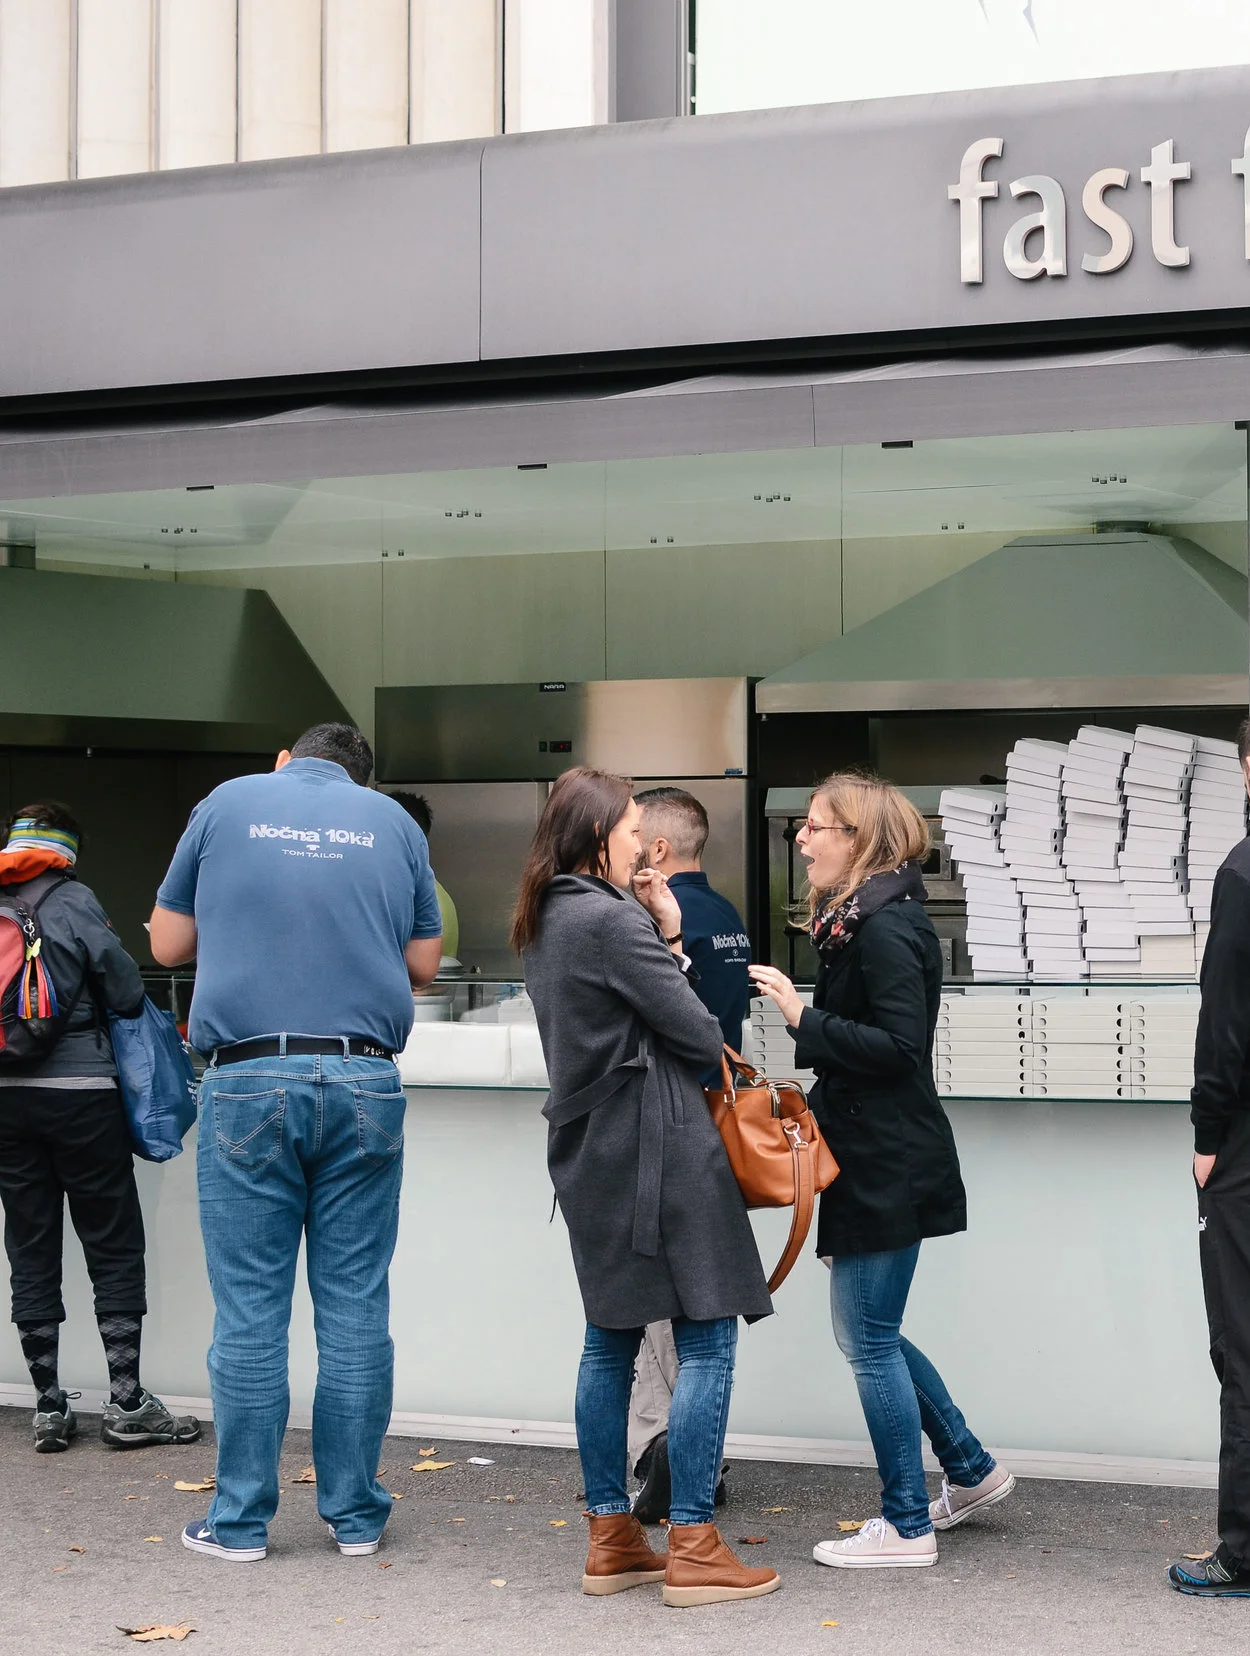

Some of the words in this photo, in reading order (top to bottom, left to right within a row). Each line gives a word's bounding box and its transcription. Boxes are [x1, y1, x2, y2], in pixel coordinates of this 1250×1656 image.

[948, 137, 1192, 284] fast
[282, 849, 304, 857] TOM
[306, 852, 344, 860] TAILOR
